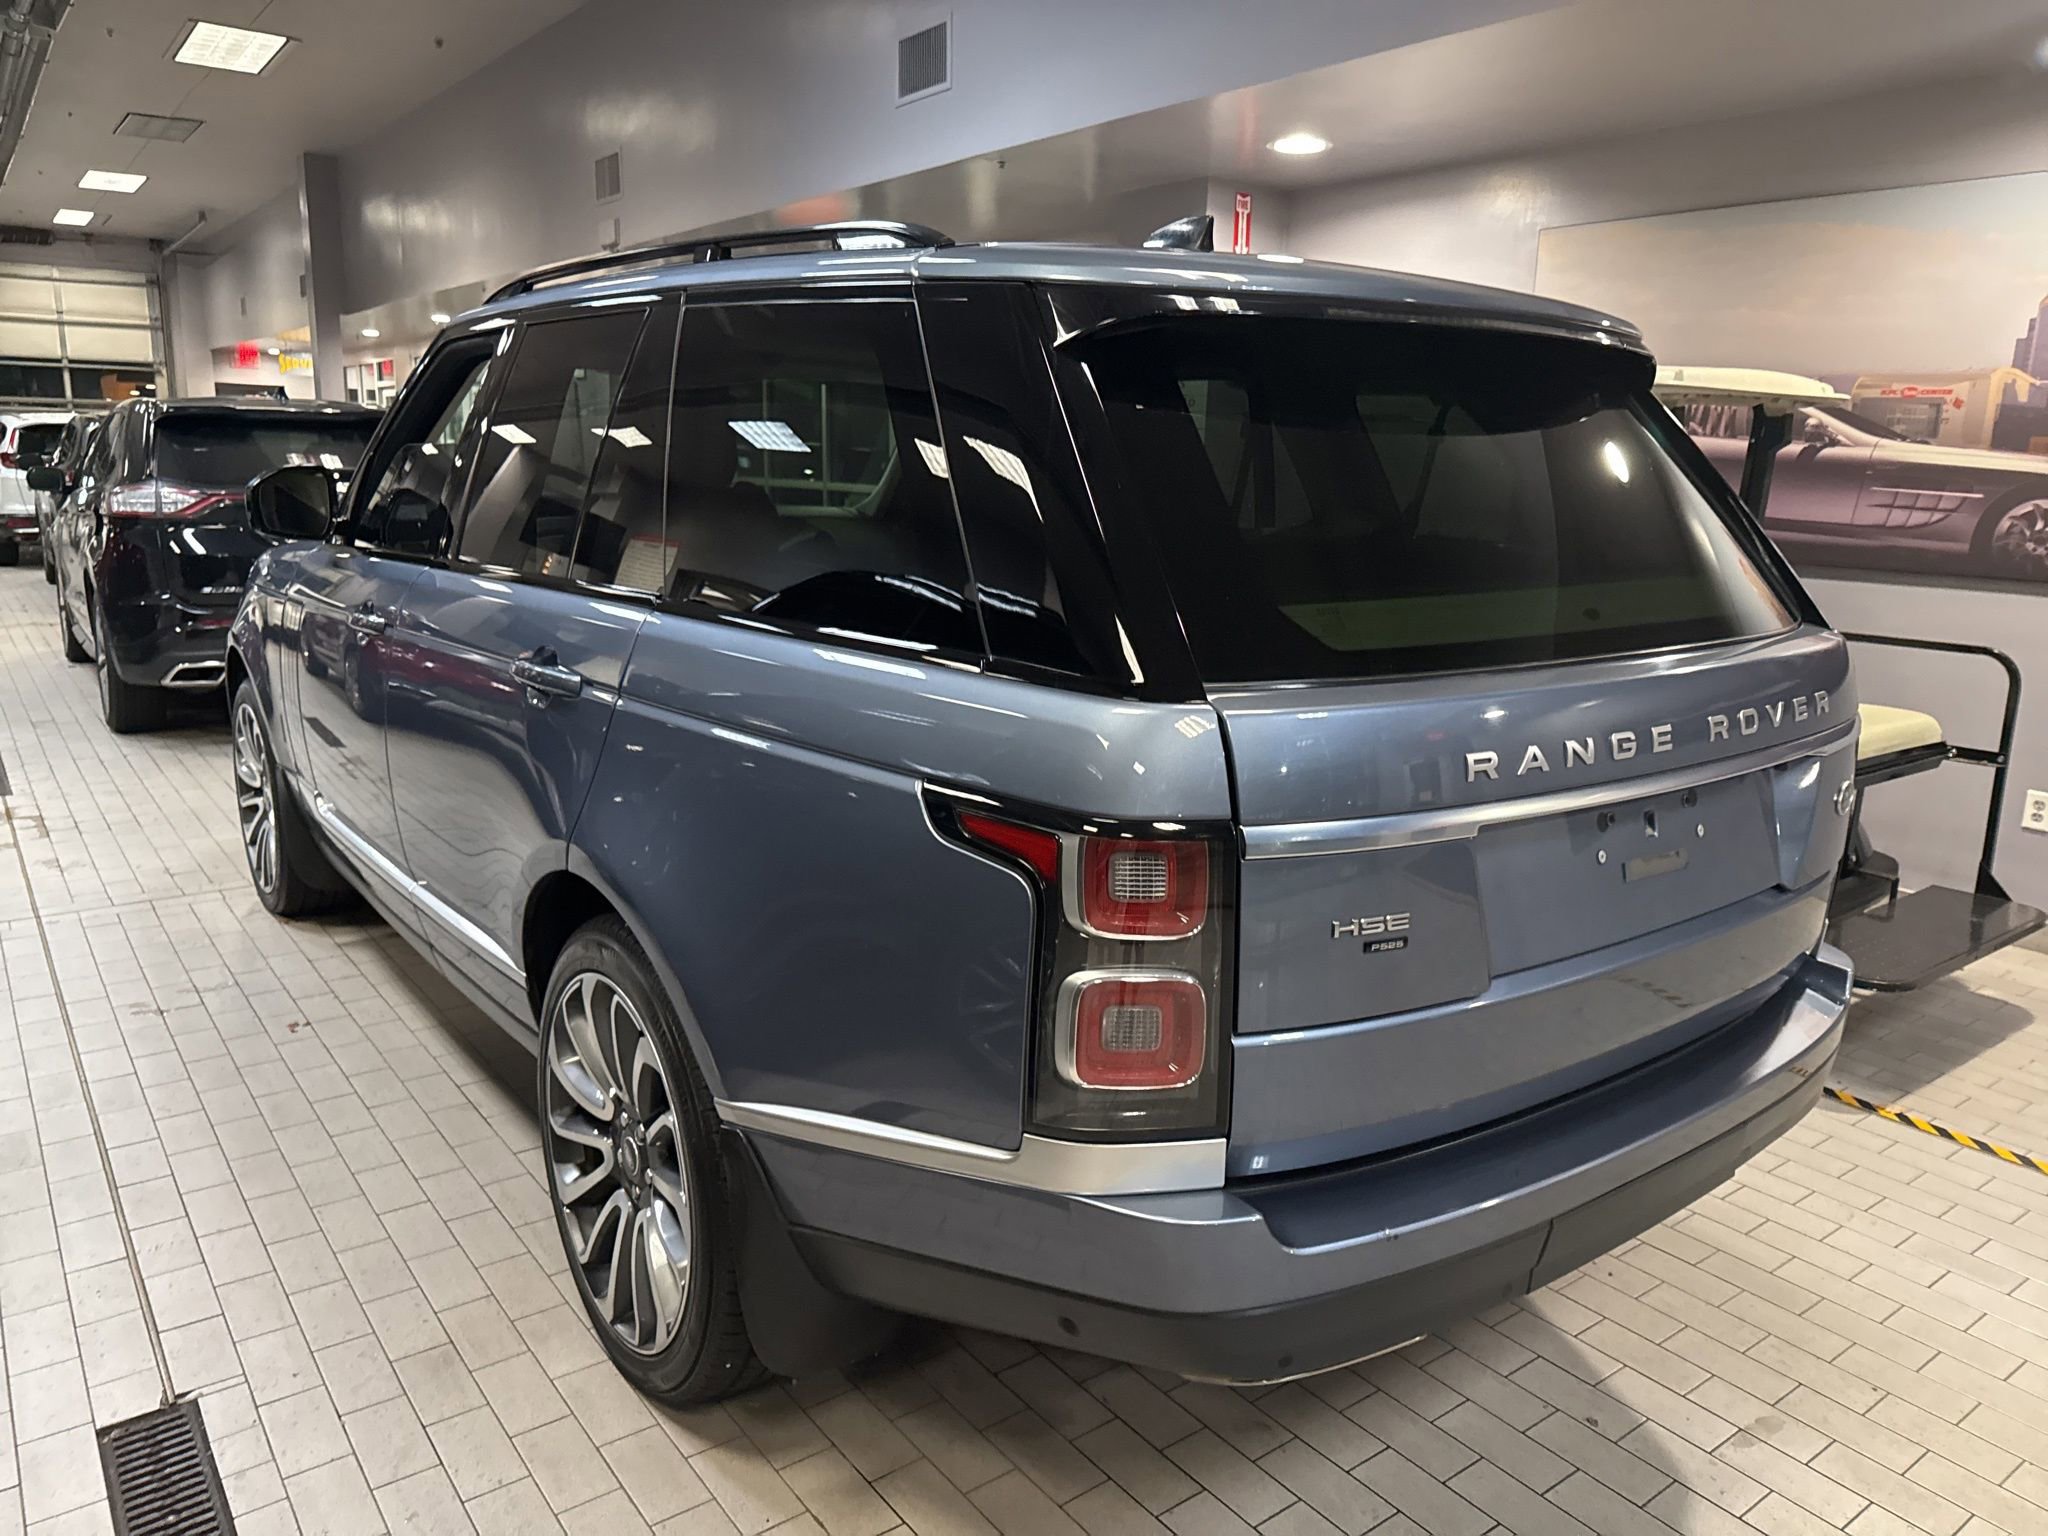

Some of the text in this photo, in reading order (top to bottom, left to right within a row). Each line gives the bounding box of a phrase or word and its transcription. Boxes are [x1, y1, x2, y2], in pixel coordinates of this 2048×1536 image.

[1465, 690, 1830, 782] RANGE ROVER
[1331, 912, 1410, 939] HSE
